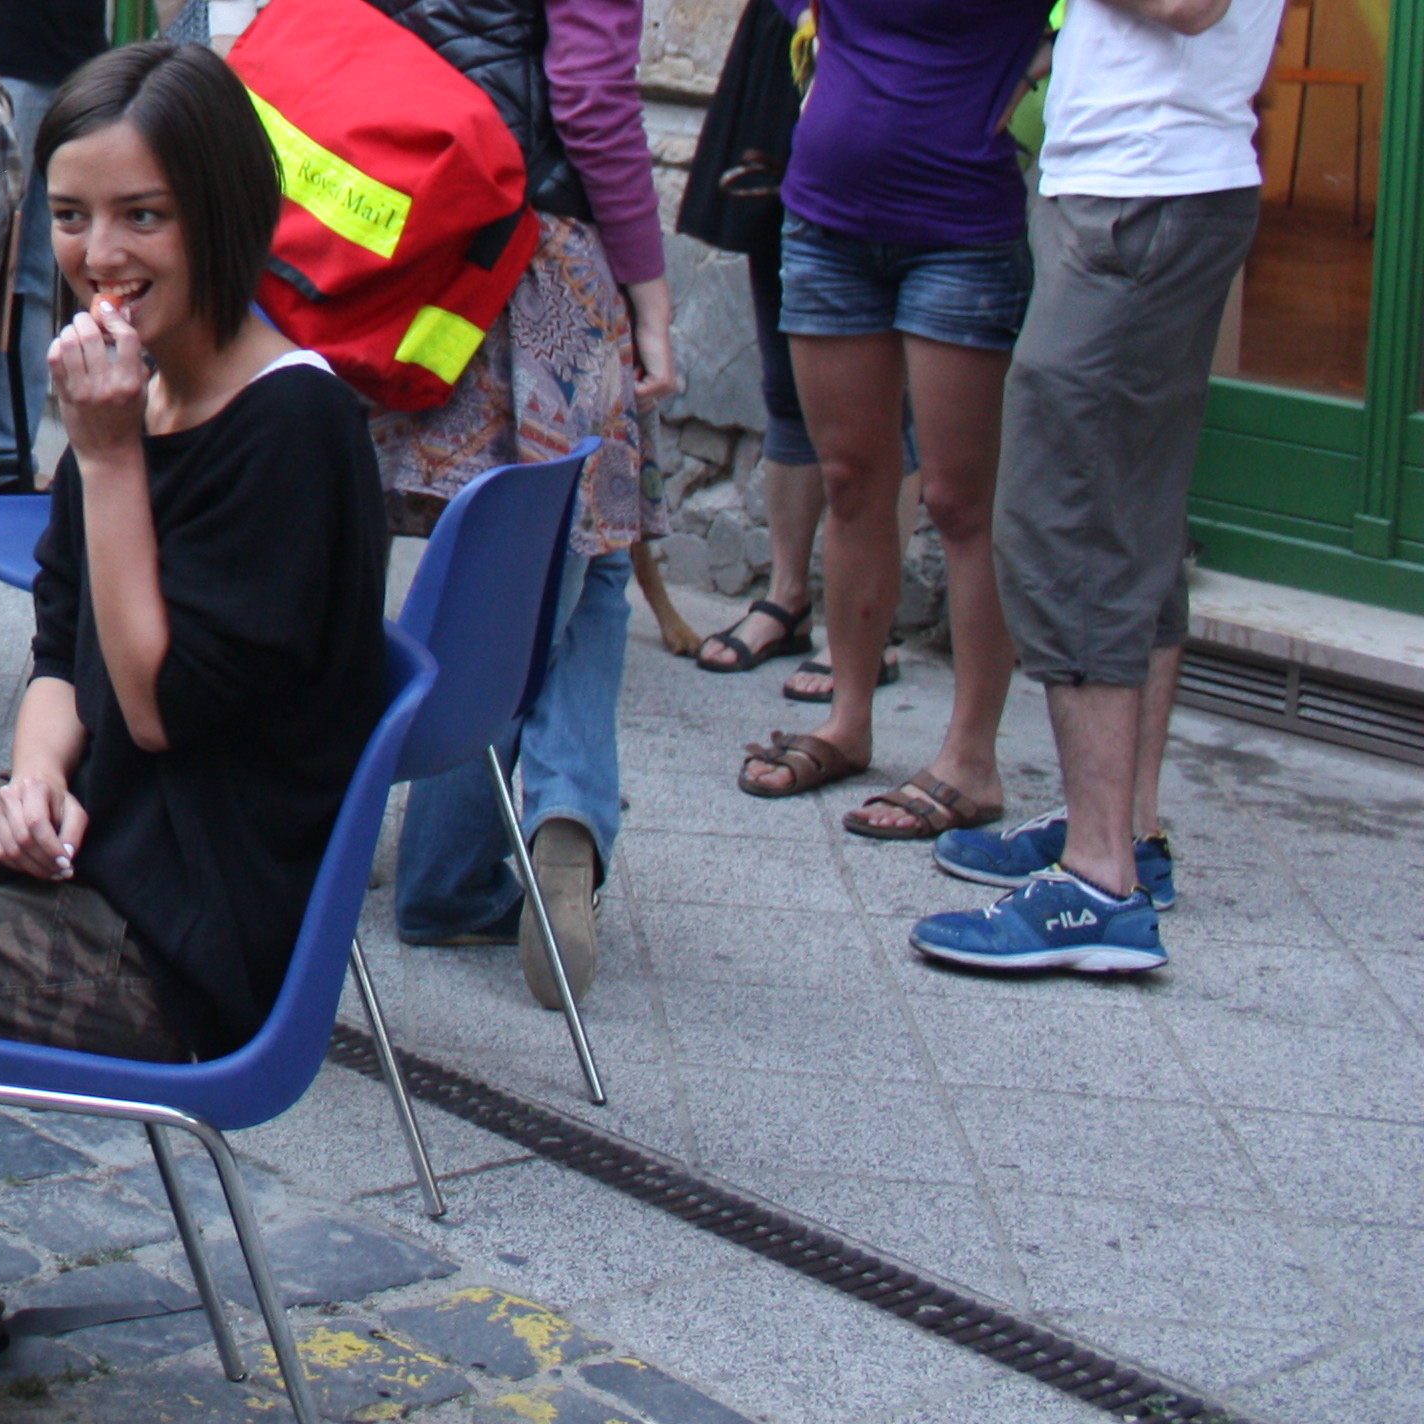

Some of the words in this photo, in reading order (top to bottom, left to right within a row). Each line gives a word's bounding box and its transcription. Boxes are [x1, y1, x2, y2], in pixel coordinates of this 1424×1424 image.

[297, 158, 343, 201] Royal
[340, 187, 396, 230] Mail
[1045, 908, 1098, 931] FILA
